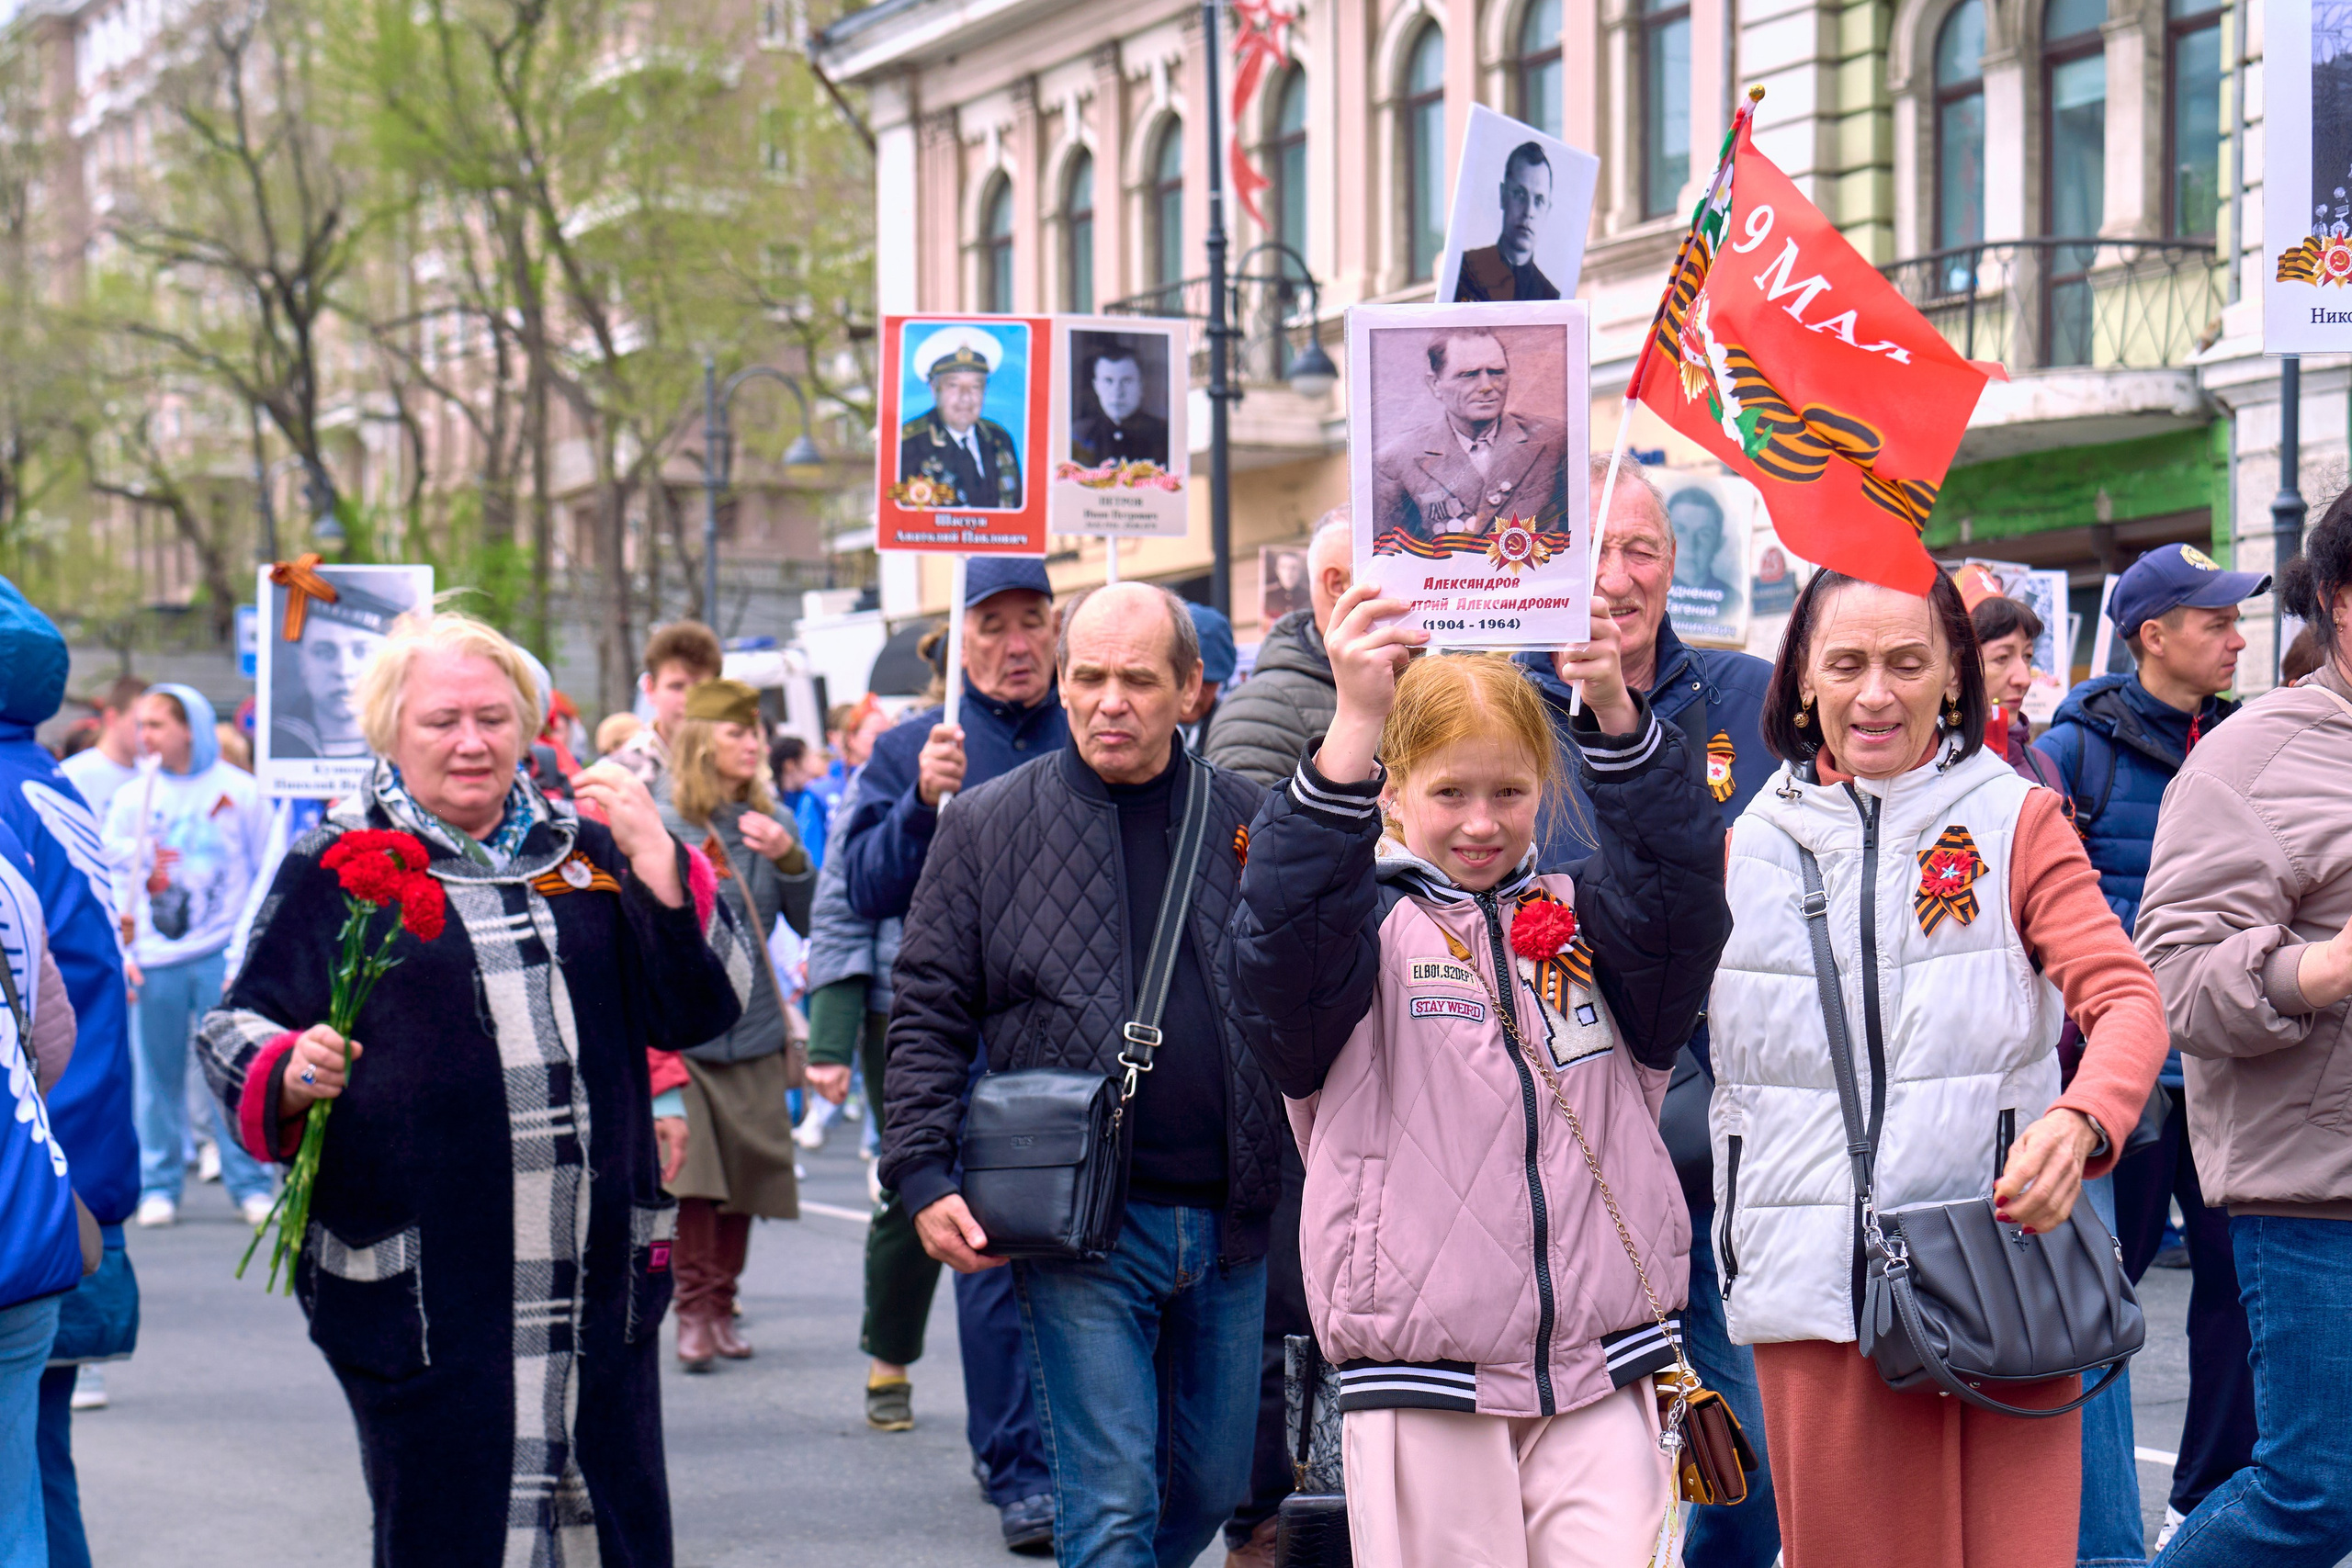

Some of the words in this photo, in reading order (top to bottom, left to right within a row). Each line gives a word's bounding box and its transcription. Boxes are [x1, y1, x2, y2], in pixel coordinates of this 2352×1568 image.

[1732, 204, 1775, 254] 9
[893, 529, 959, 544] Анатолий
[961, 530, 1029, 546] Павлович
[1408, 597, 1449, 611] ИТРИЙ
[1422, 619, 1465, 630] (1904
[1477, 617, 1521, 630] 1964)
[1416, 1000, 1446, 1013] STAY
[1446, 1001, 1481, 1019] WEIRD
